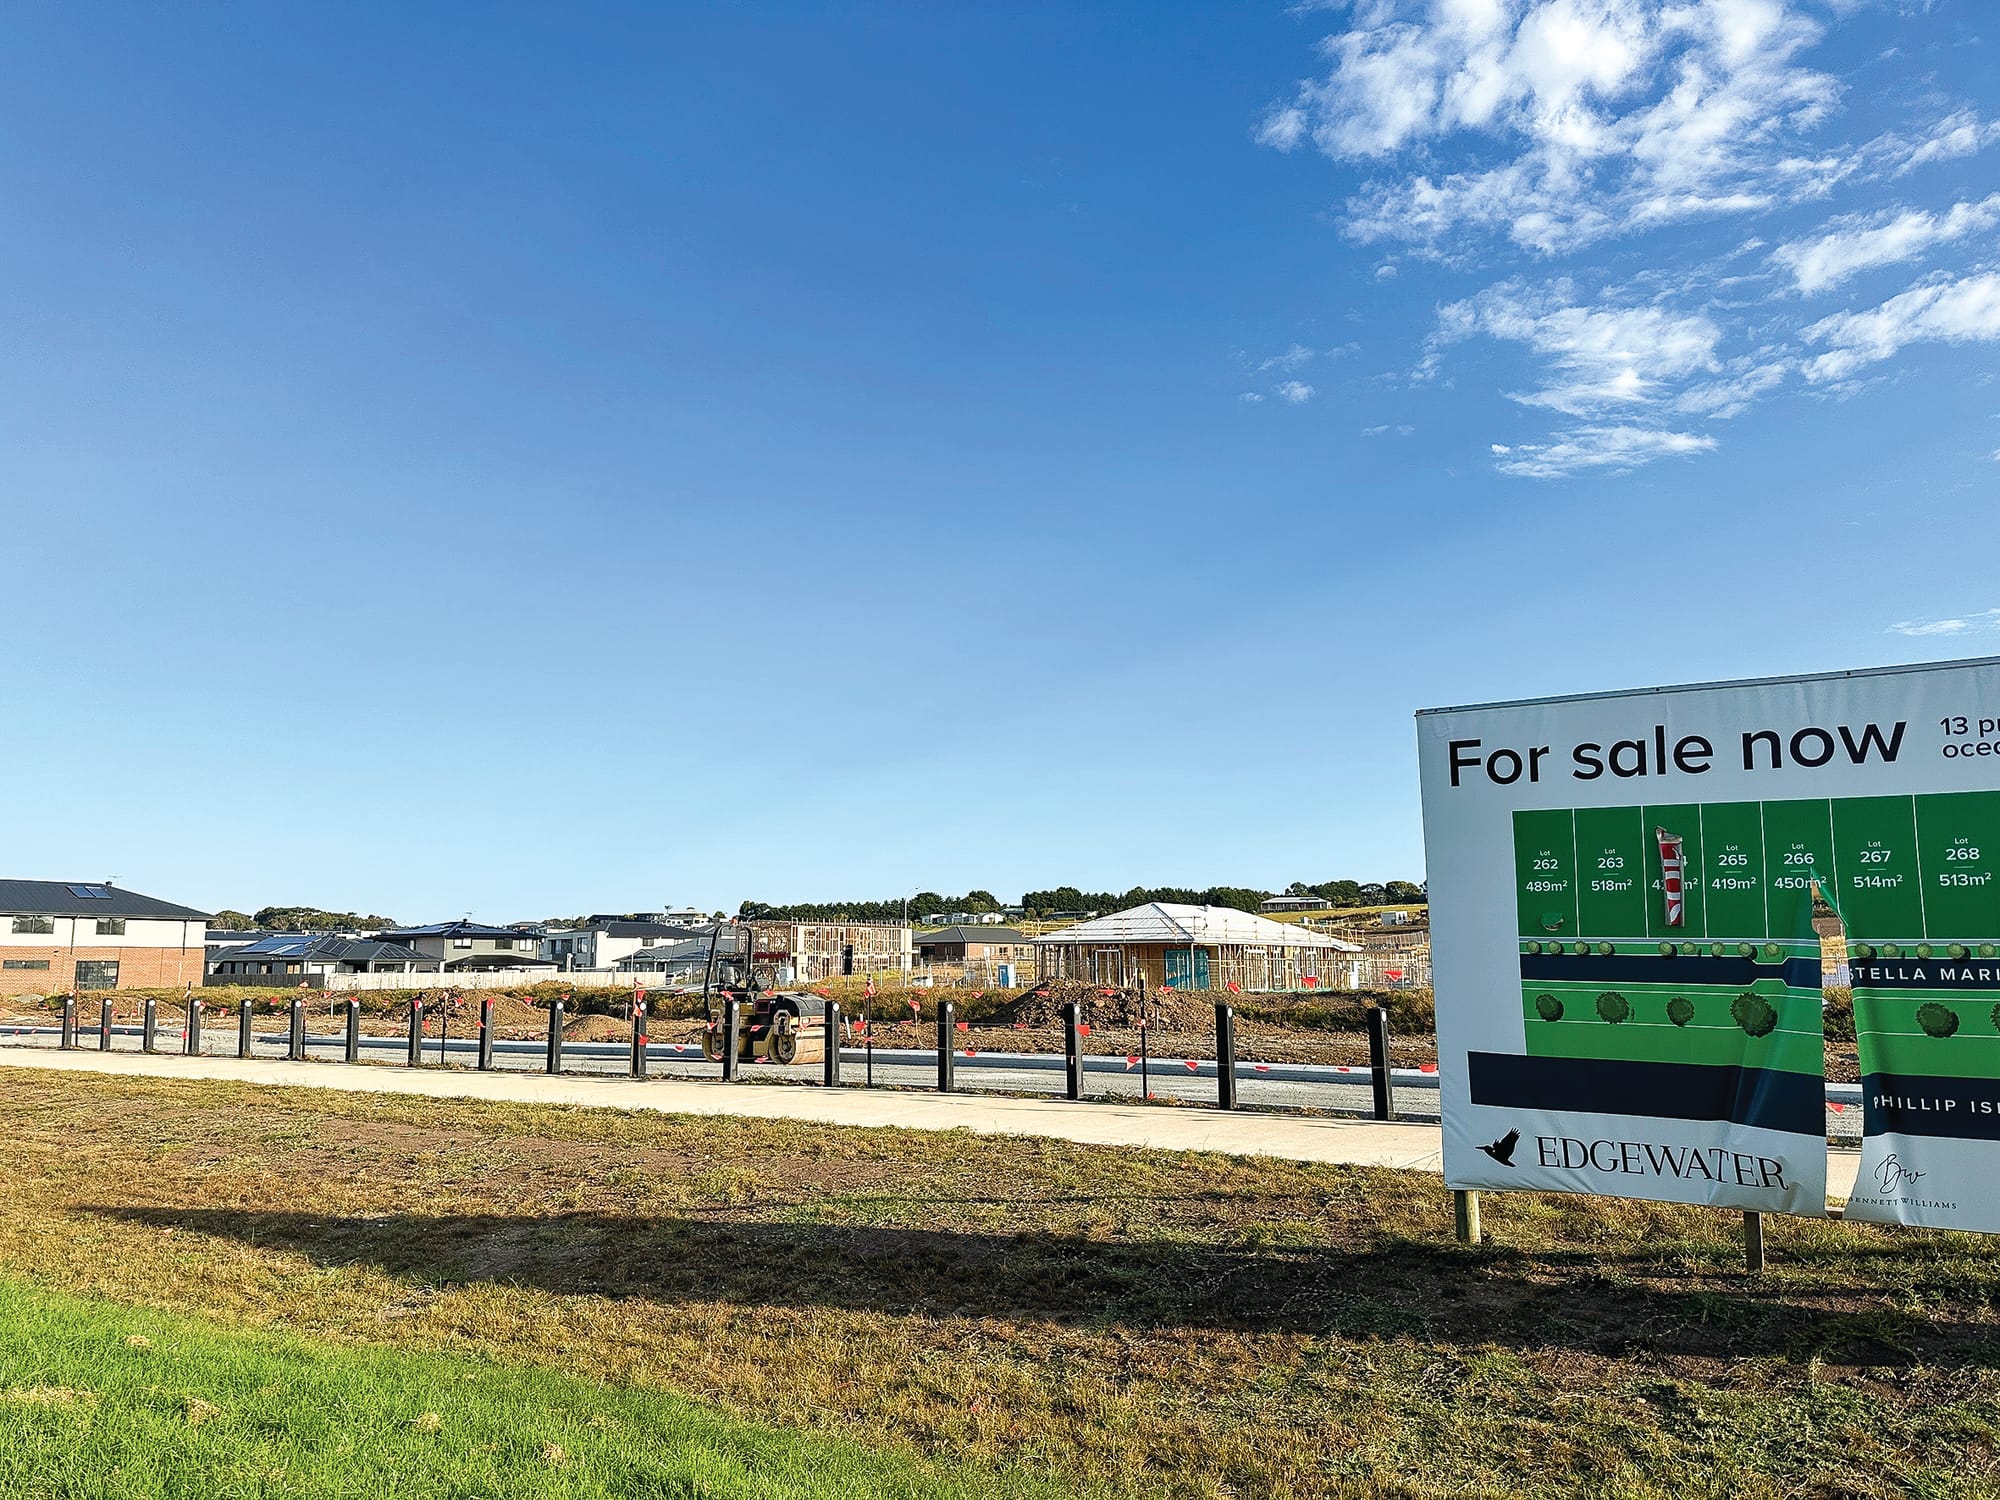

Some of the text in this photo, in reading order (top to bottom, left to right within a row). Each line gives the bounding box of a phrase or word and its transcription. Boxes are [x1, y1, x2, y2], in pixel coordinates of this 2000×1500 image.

[1940, 716, 2000, 738] 13 p
[1448, 721, 1907, 787] For sale now
[1867, 840, 1882, 848] Lot
[1954, 837, 1969, 845] Lot
[1725, 844, 1739, 852] Lot
[1945, 847, 1980, 861] 268
[1597, 856, 1624, 869] 263
[1718, 854, 1748, 866] 265
[1783, 852, 1815, 865] 266
[1859, 850, 1892, 863] 267
[1533, 858, 1559, 870] 262
[1525, 879, 1568, 892] 489m²
[1591, 878, 1633, 892] 518m²
[1711, 876, 1757, 890] 419m²
[1853, 874, 1904, 888] 514m²
[1939, 872, 1992, 887] 513m²
[1873, 1095, 2000, 1114] PHILLIP IS
[1534, 1135, 1789, 1191] EDGEWATER
